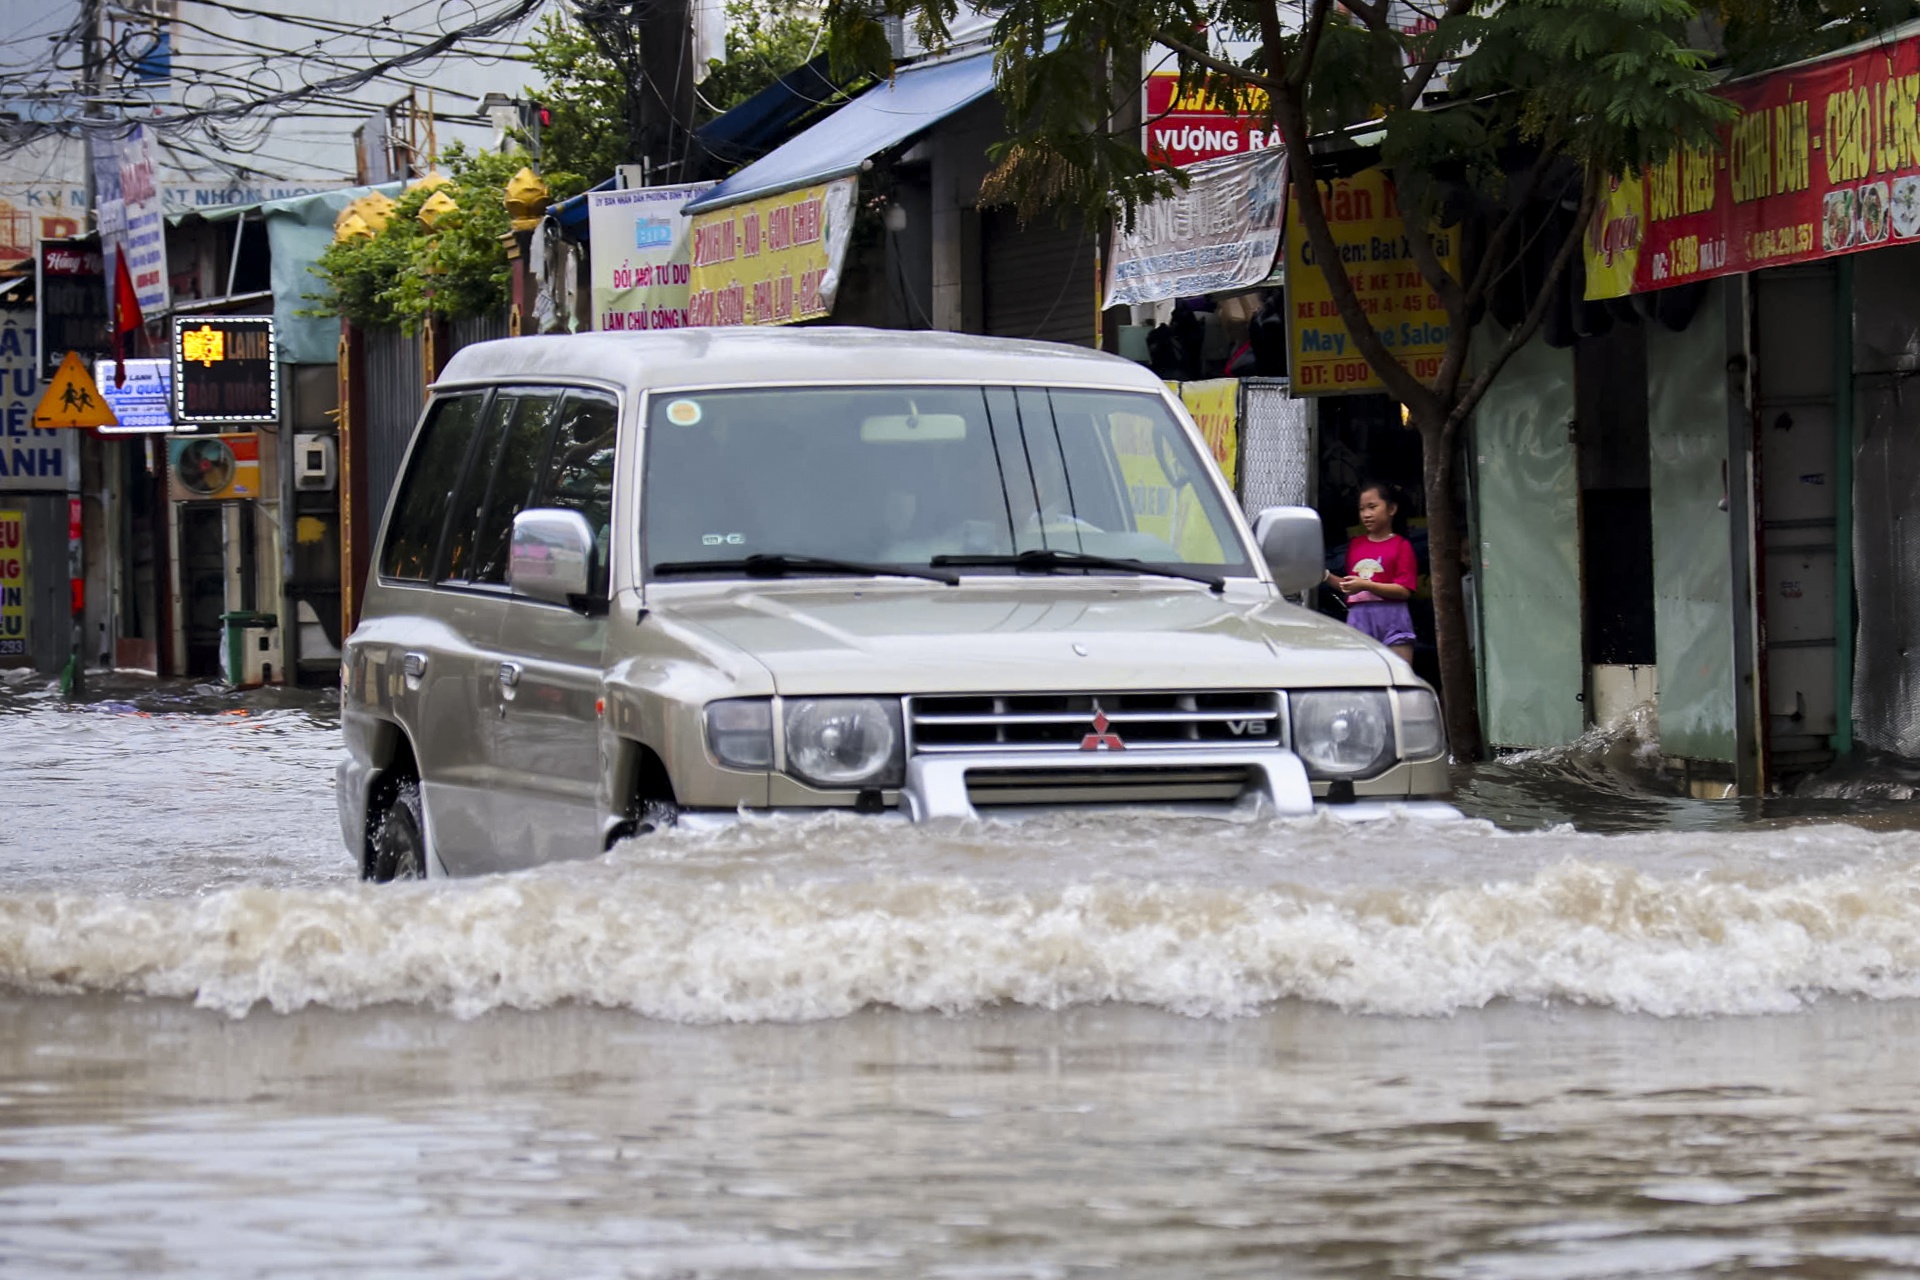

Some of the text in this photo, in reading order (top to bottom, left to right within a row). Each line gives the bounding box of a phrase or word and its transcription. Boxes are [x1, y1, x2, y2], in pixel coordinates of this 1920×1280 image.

[1155, 126, 1239, 156] VƯỢNG
[1731, 111, 1772, 204] CANH
[1775, 83, 1810, 195] BÚN
[1825, 68, 1871, 185] CHÁO
[793, 192, 821, 246] CHIÊN
[613, 259, 632, 288] ĐỔI
[656, 262, 670, 285] TƯ
[602, 308, 624, 331] LÀM
[628, 303, 648, 330] CHỦ
[651, 304, 679, 329] CÔNG
[1302, 328, 1345, 356] May
[1334, 362, 1368, 383] 090
[1226, 720, 1268, 736] V6
